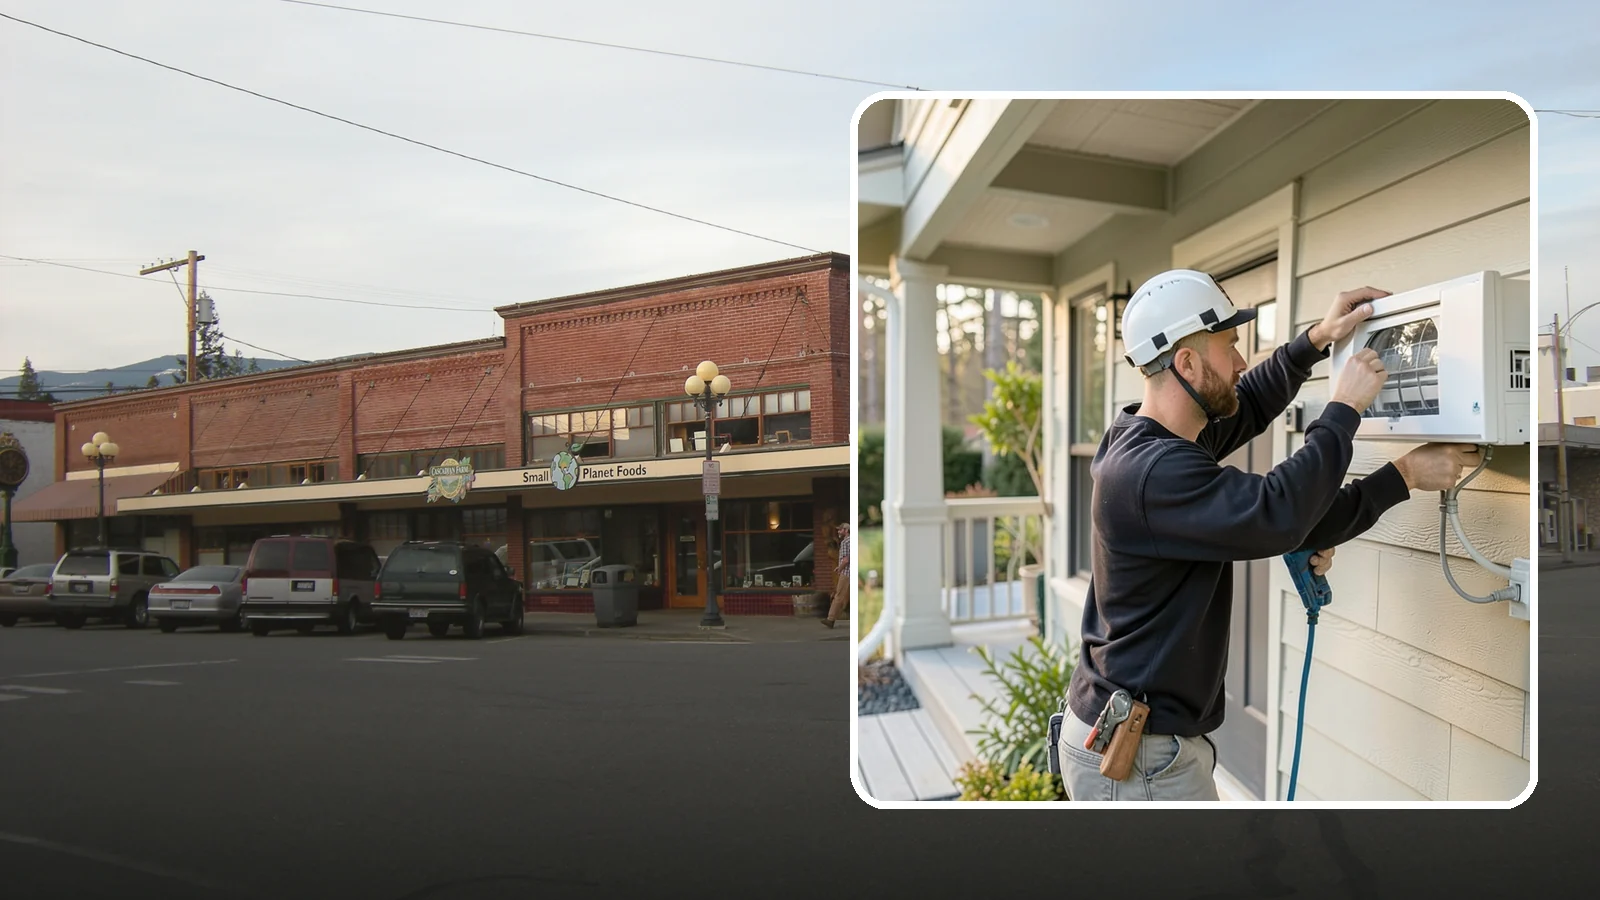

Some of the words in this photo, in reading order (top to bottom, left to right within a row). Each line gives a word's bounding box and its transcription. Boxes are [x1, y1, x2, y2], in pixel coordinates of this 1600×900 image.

[523, 471, 549, 483] Small
[583, 467, 614, 479] Planet
[617, 464, 647, 477] Foods
